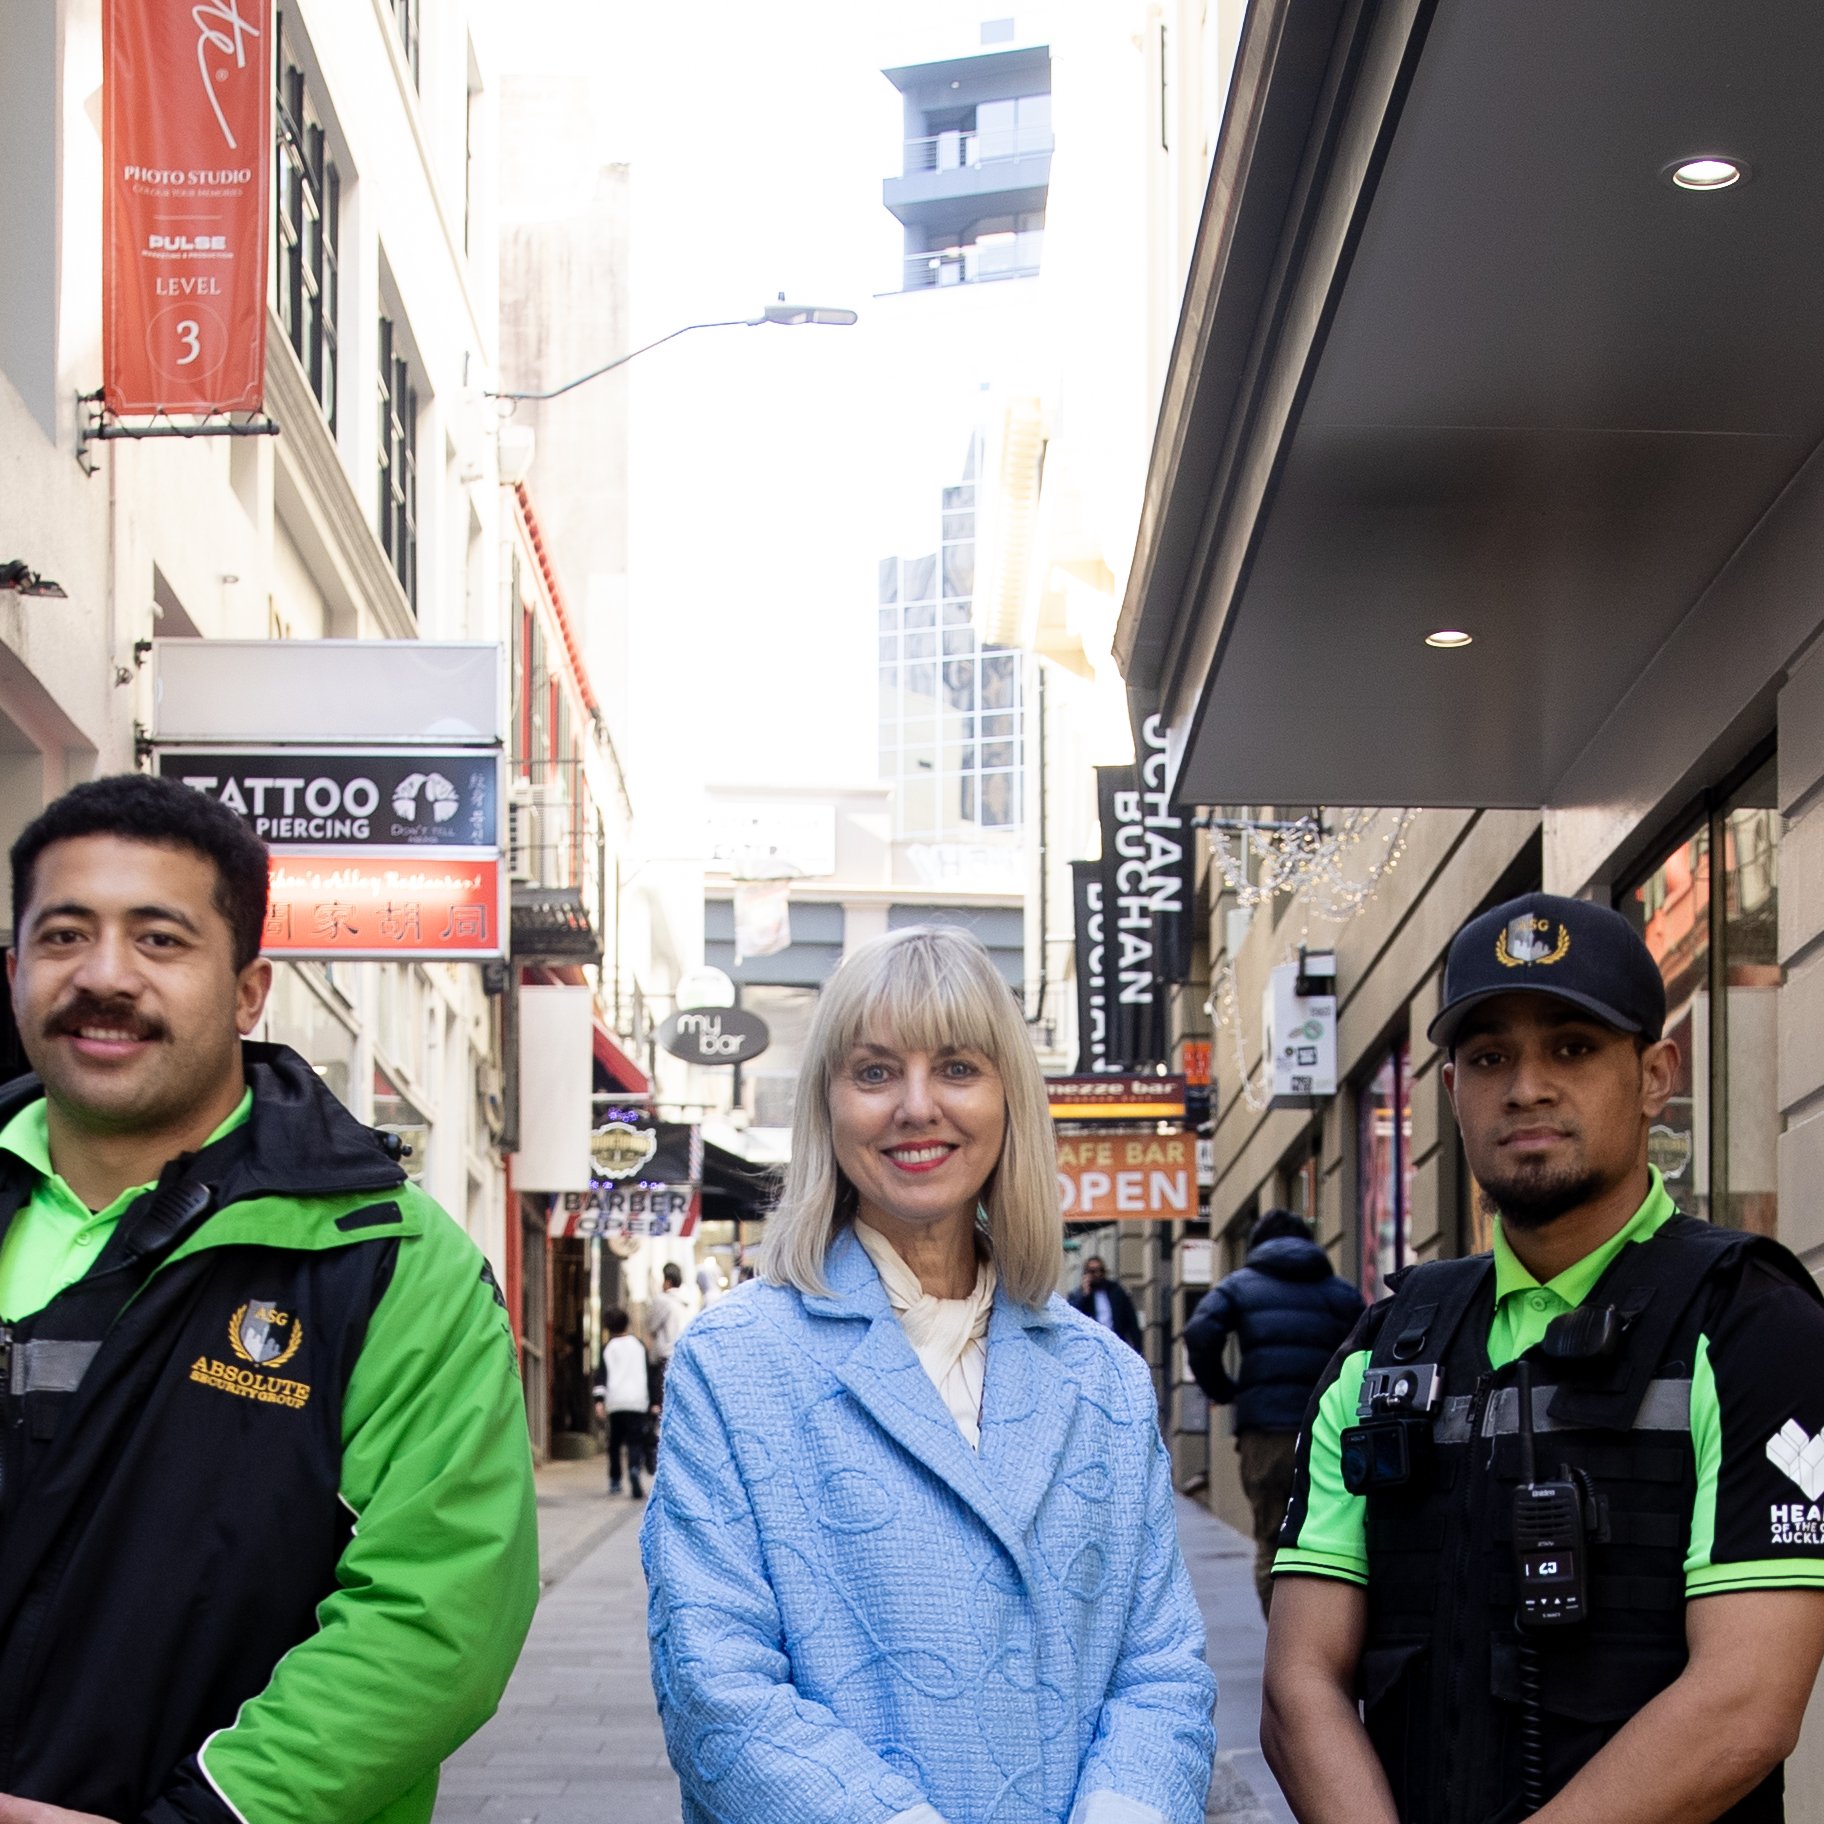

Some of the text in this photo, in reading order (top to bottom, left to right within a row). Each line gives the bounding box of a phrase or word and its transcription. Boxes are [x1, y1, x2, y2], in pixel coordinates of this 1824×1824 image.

[123, 165, 252, 185] PHOTO STUDIO
[148, 235, 226, 251] PULSE
[155, 277, 222, 296] LEVEL
[176, 320, 201, 366] 3
[182, 776, 380, 818] TATTOO
[1142, 713, 1182, 912] UCHAN
[256, 817, 371, 840] PIERCING
[1114, 791, 1153, 1004] BUCHAN
[677, 1013, 722, 1040] my
[698, 1032, 746, 1055] bar
[1131, 1080, 1176, 1096] bar
[1057, 1142, 1114, 1167] AFE
[1126, 1141, 1185, 1166] BAR
[564, 1191, 687, 1212] BARBER
[579, 1217, 671, 1232] OPEN
[189, 1370, 306, 1409] SECURITY GROUP
[191, 1356, 311, 1401] ABSOLUTE
[1771, 1523, 1791, 1534] OF
[1795, 1521, 1817, 1533] THE
